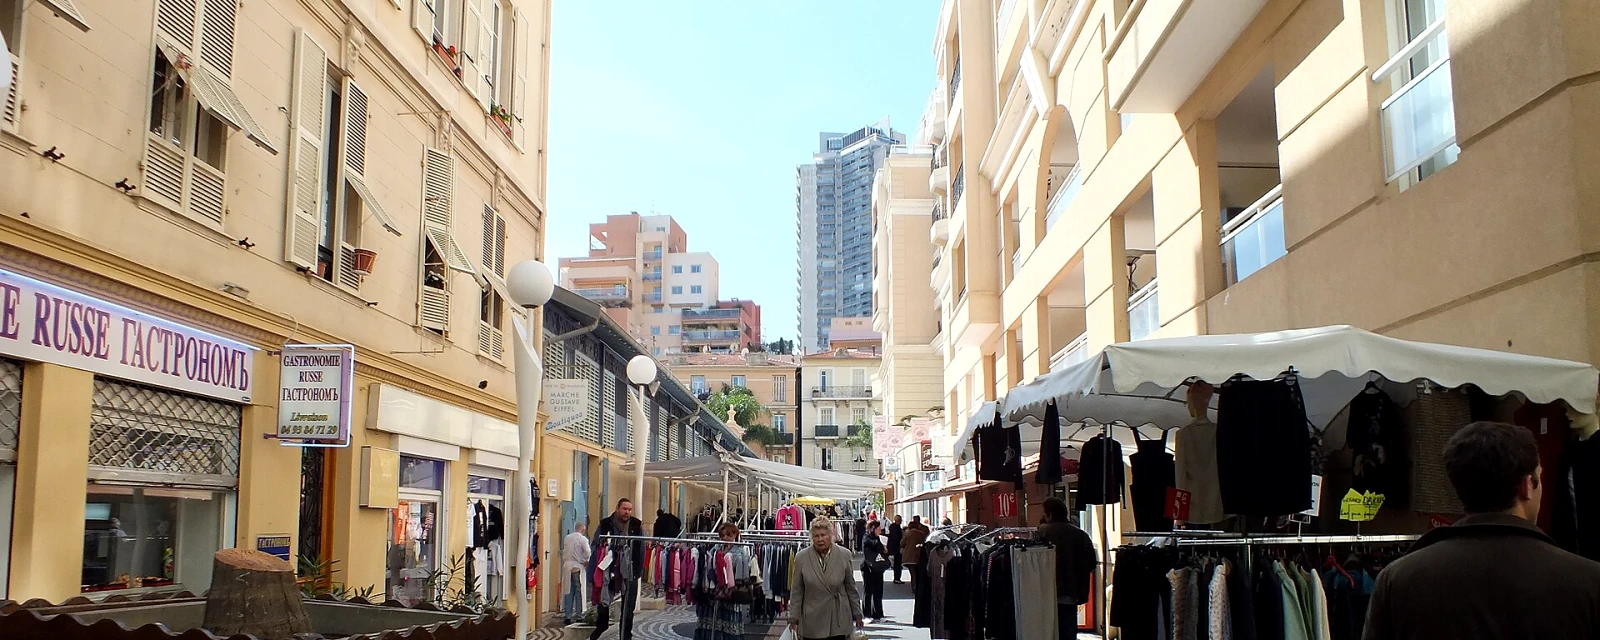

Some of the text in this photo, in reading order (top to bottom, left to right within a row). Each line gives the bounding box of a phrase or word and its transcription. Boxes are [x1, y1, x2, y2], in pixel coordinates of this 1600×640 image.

[32, 292, 110, 360] RUSSE
[120, 317, 249, 391] ГАСТРОНОМЪ
[283, 355, 340, 367] GASTRONOMIE
[299, 371, 323, 383] RUSSE
[282, 387, 339, 401] ГАСТРОНОМЪ
[290, 412, 328, 421] Livraison
[545, 411, 583, 431] Boutiques
[292, 425, 302, 435] 93
